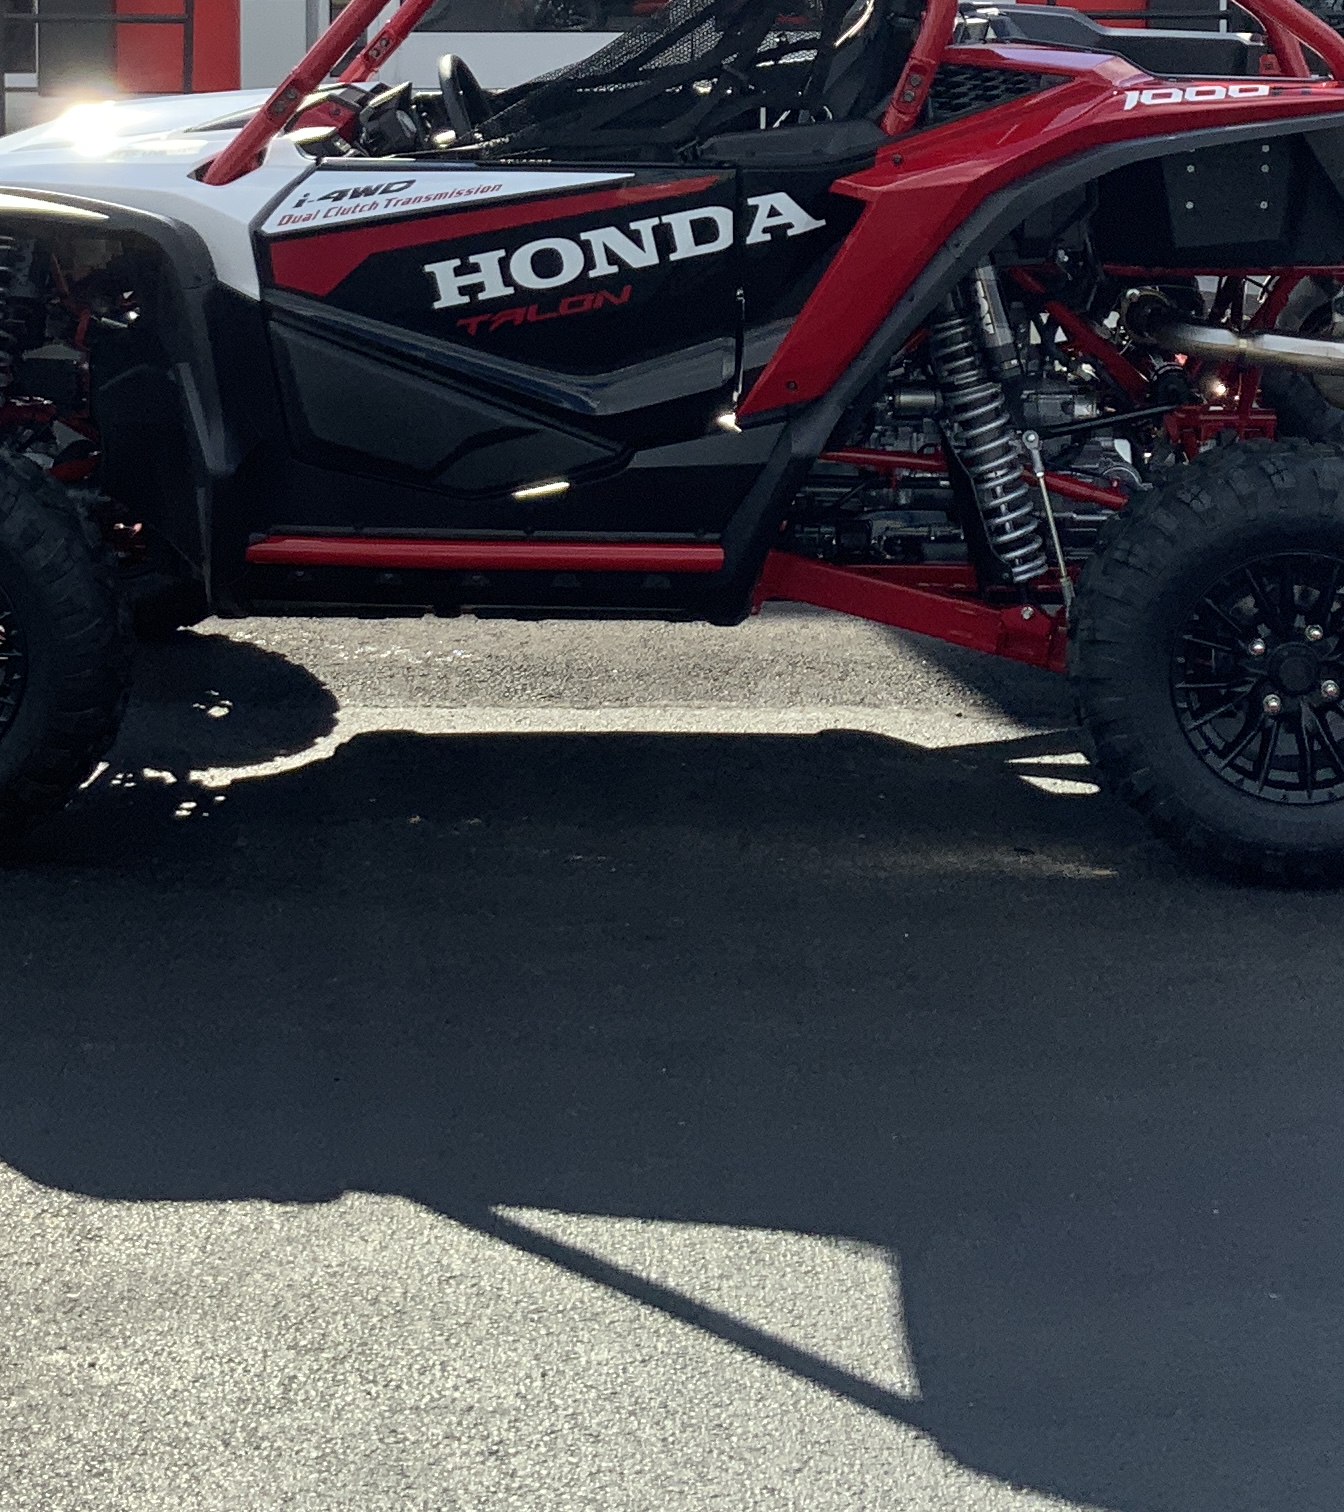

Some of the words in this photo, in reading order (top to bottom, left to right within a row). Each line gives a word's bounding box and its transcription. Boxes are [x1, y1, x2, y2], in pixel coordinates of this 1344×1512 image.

[1123, 84, 1270, 111] 1000
[277, 210, 318, 226] Dual
[323, 199, 379, 218] Clutch
[383, 183, 503, 209] Transmission
[292, 179, 416, 209] i-4WD
[424, 191, 826, 309] HONDA
[457, 285, 632, 336] TALON
